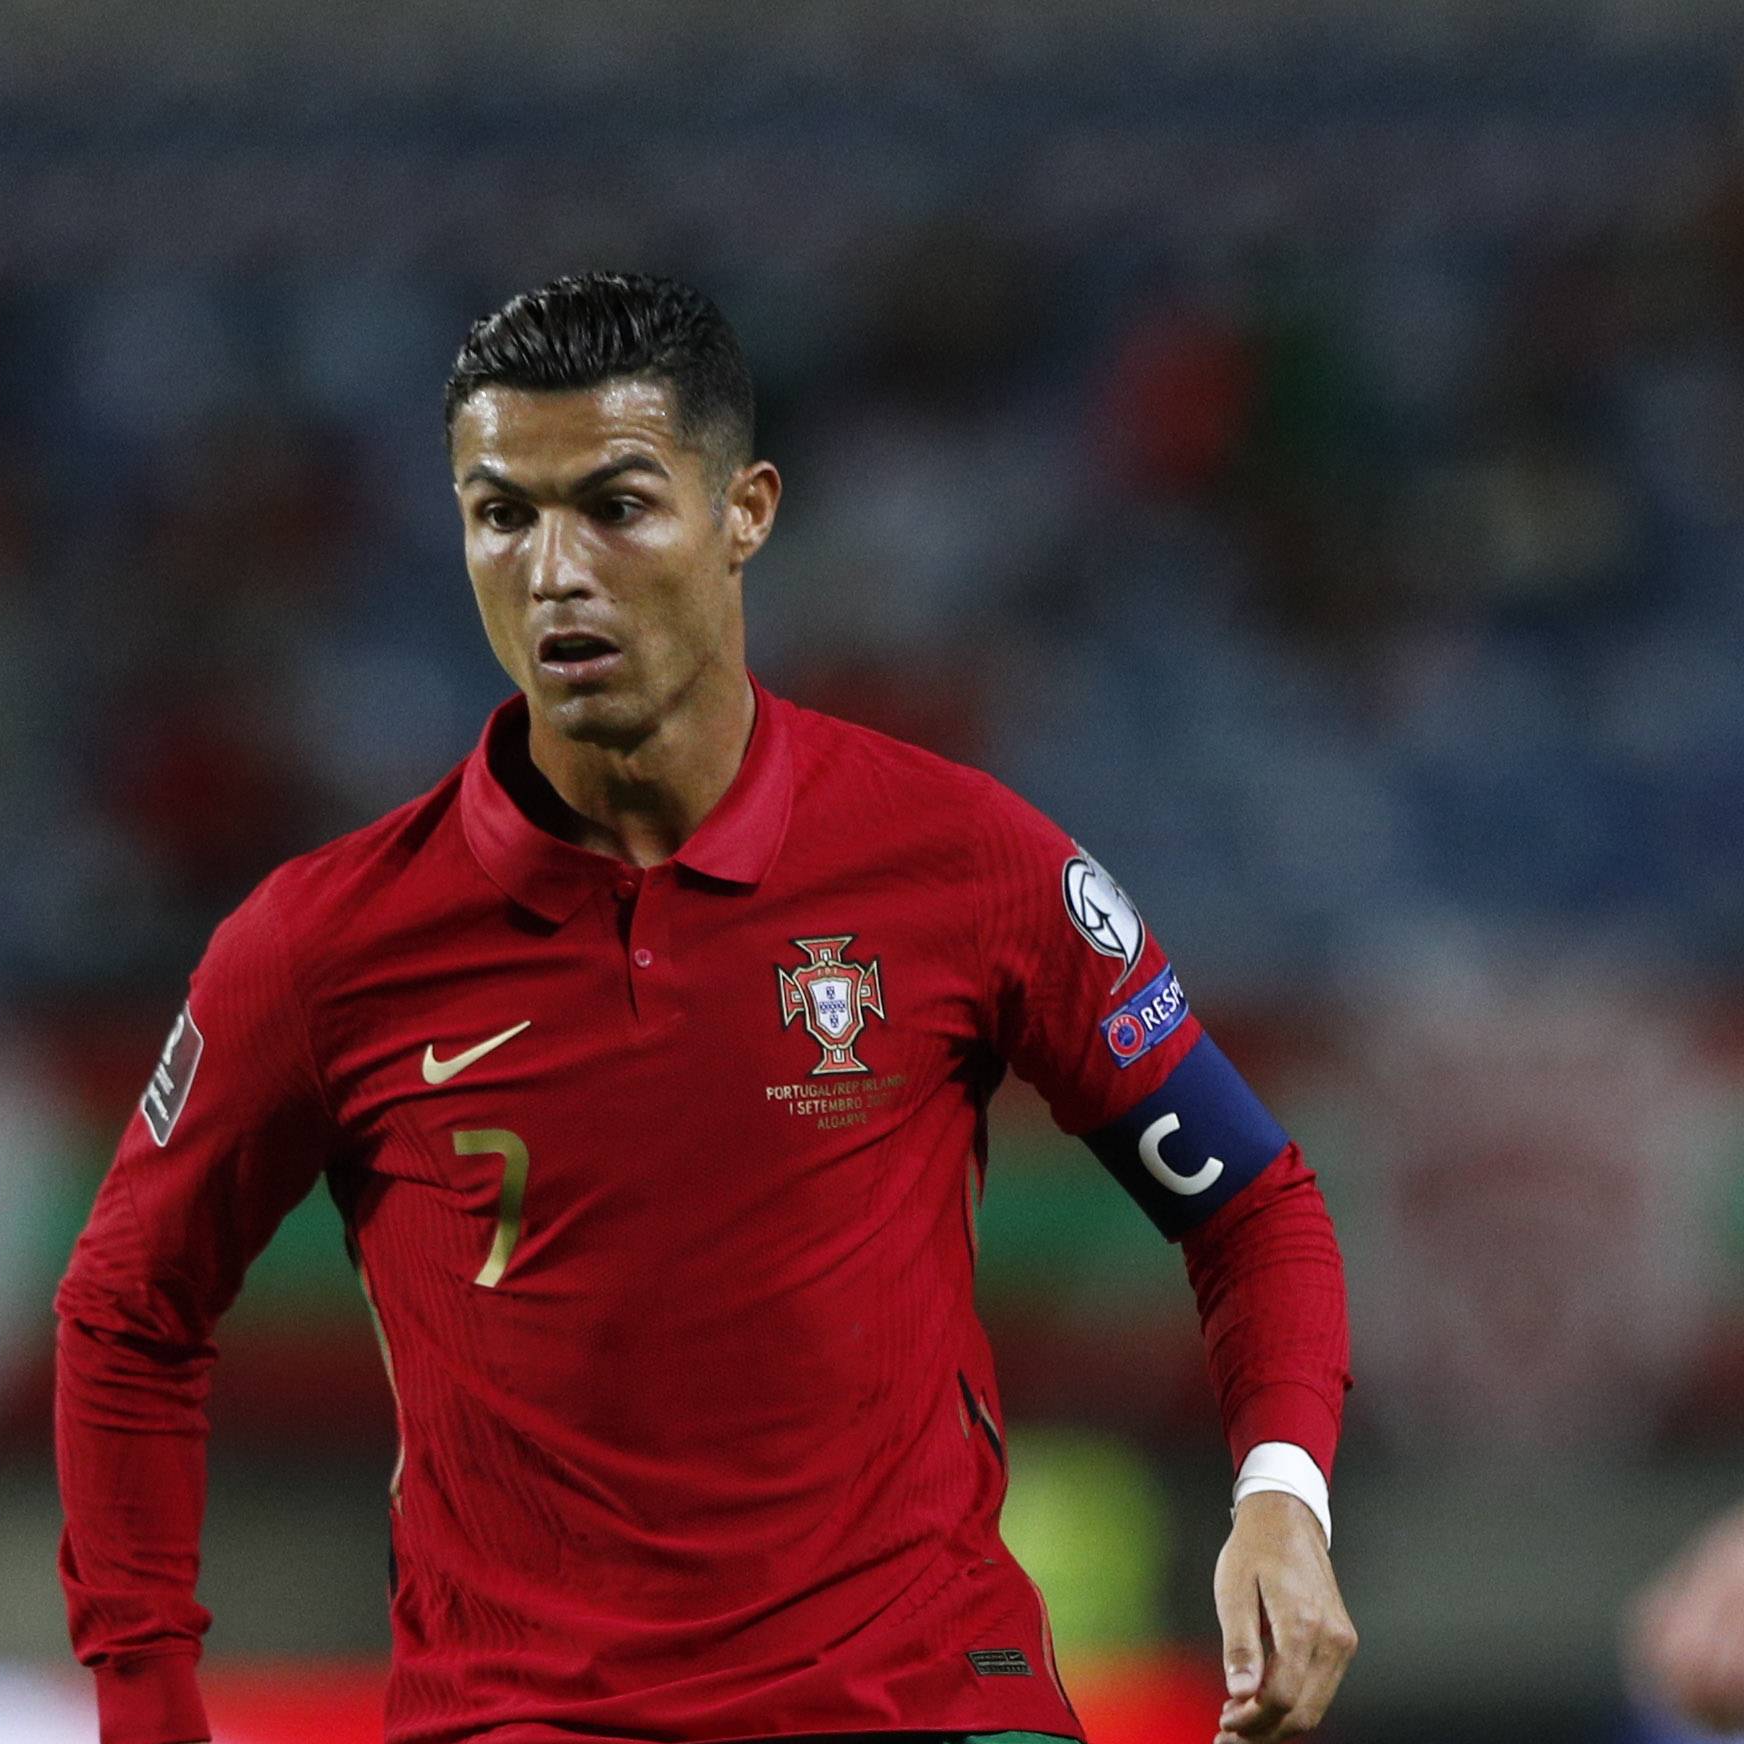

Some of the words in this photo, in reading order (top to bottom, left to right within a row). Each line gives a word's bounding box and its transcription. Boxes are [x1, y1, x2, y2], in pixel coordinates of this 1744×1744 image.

[797, 1097, 863, 1116] SETEMBRO
[817, 1112, 868, 1130] ALGARVE
[1139, 1112, 1224, 1195] C
[452, 1128, 530, 1288] 7
